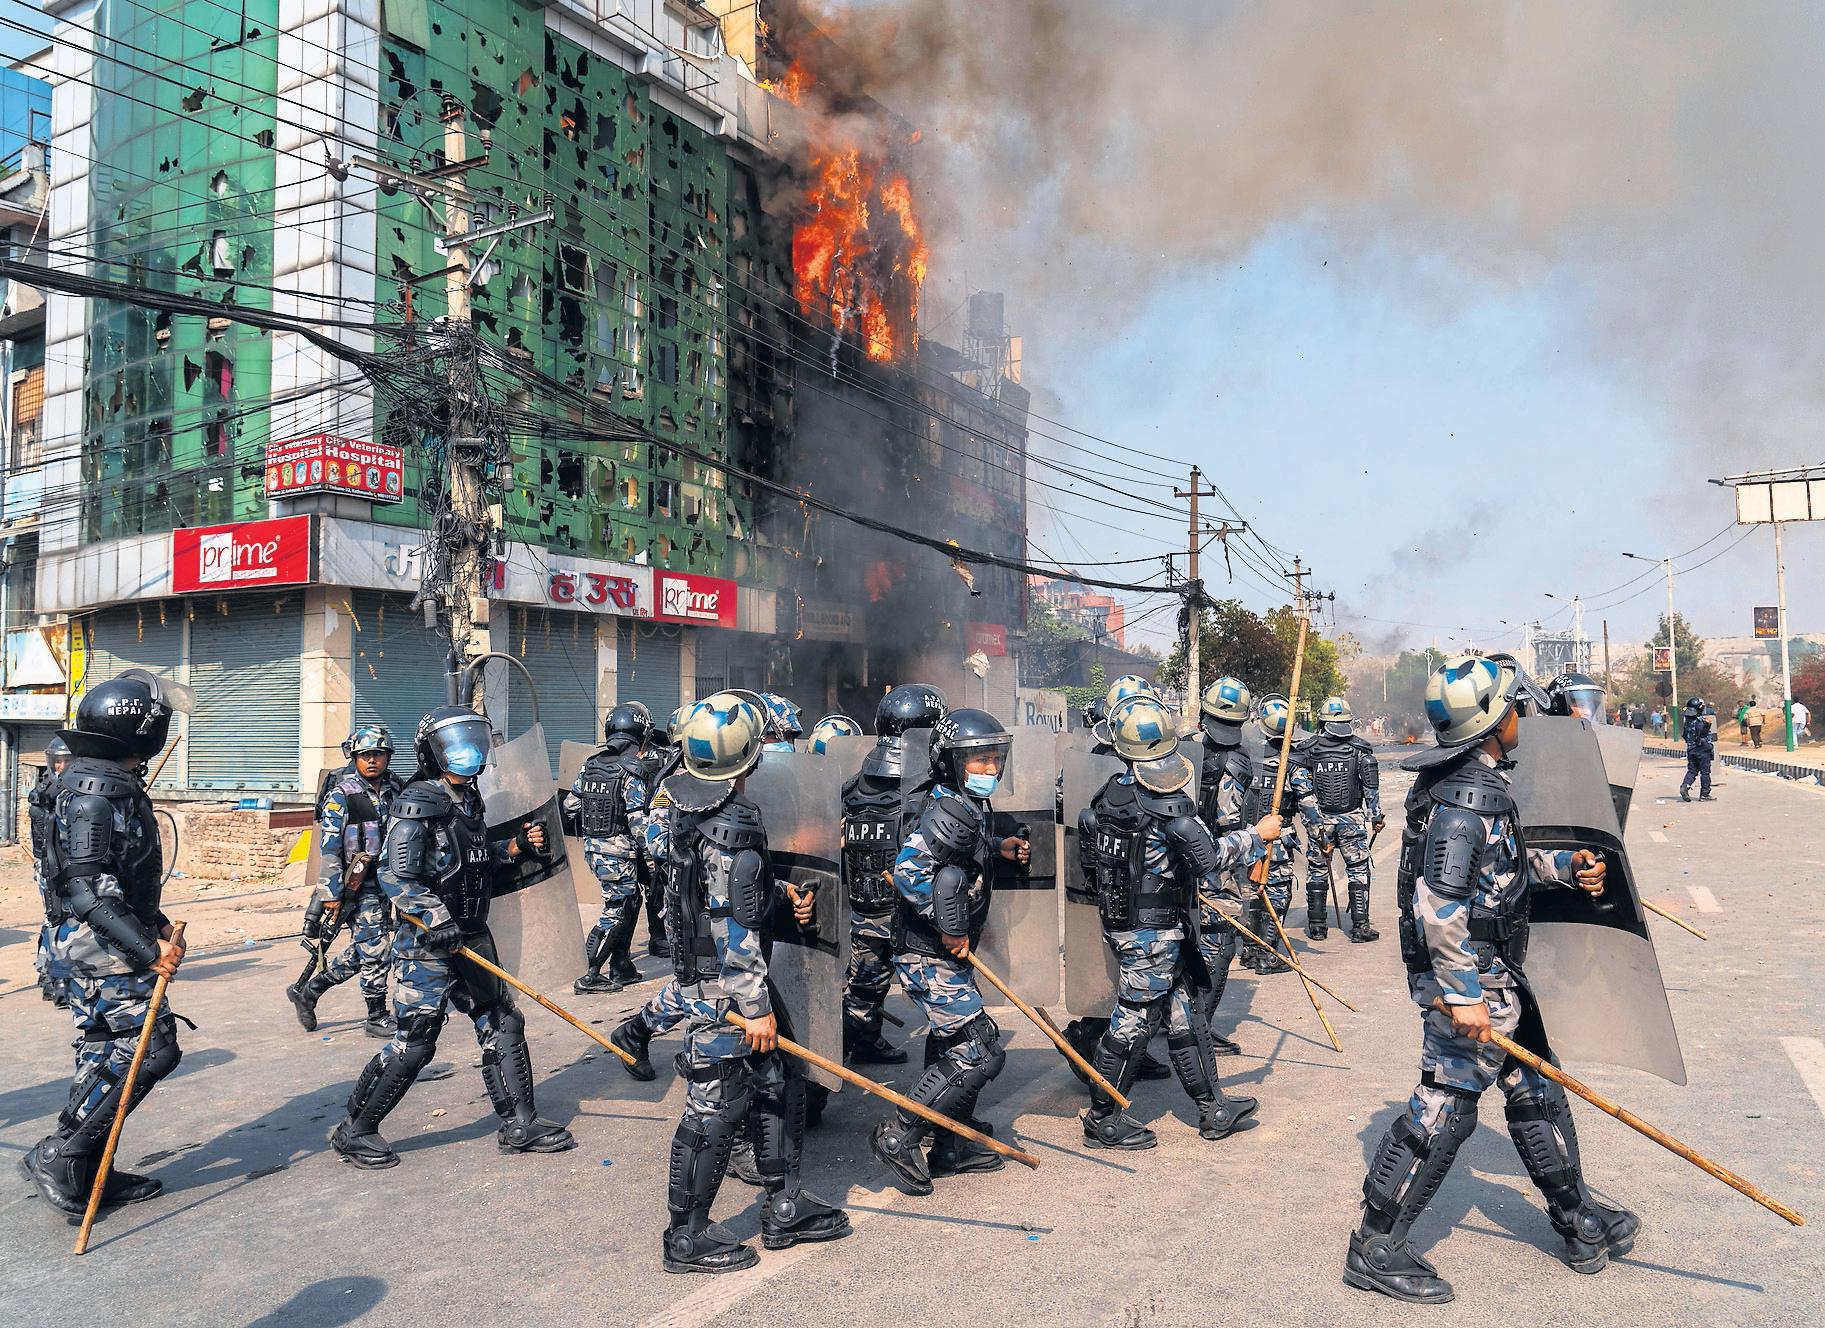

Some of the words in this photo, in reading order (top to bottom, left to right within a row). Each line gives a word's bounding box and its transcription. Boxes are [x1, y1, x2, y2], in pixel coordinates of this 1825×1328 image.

[325, 445, 401, 470] Hospital
[349, 440, 401, 459] Veterinary
[202, 539, 278, 575] prime
[665, 586, 719, 610] prime
[1316, 762, 1349, 773] A.P.F.
[583, 781, 610, 794] A.P.F.
[848, 823, 891, 841] A.P.F.
